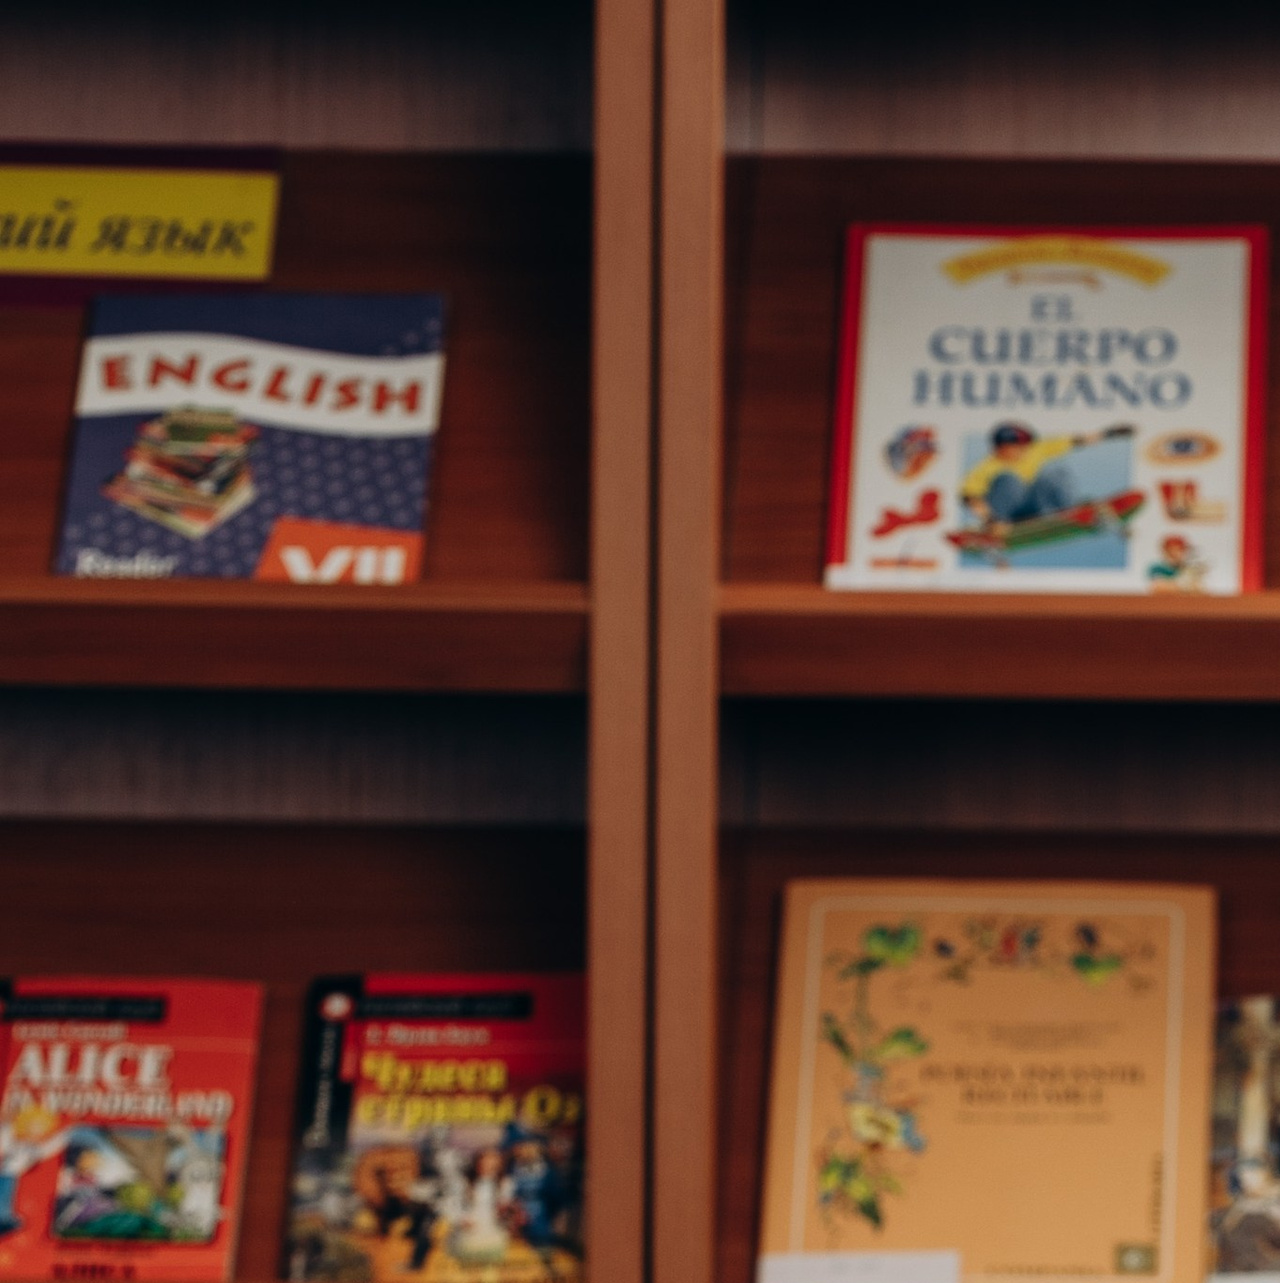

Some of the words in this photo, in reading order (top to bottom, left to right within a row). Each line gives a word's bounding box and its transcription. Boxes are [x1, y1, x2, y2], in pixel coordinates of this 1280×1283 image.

[928, 325, 1179, 366] CUERPO
[99, 352, 424, 416] ENGLISH
[911, 369, 1193, 410] HUMANO
[279, 545, 406, 586] VII
[11, 1043, 173, 1088] ALICE
